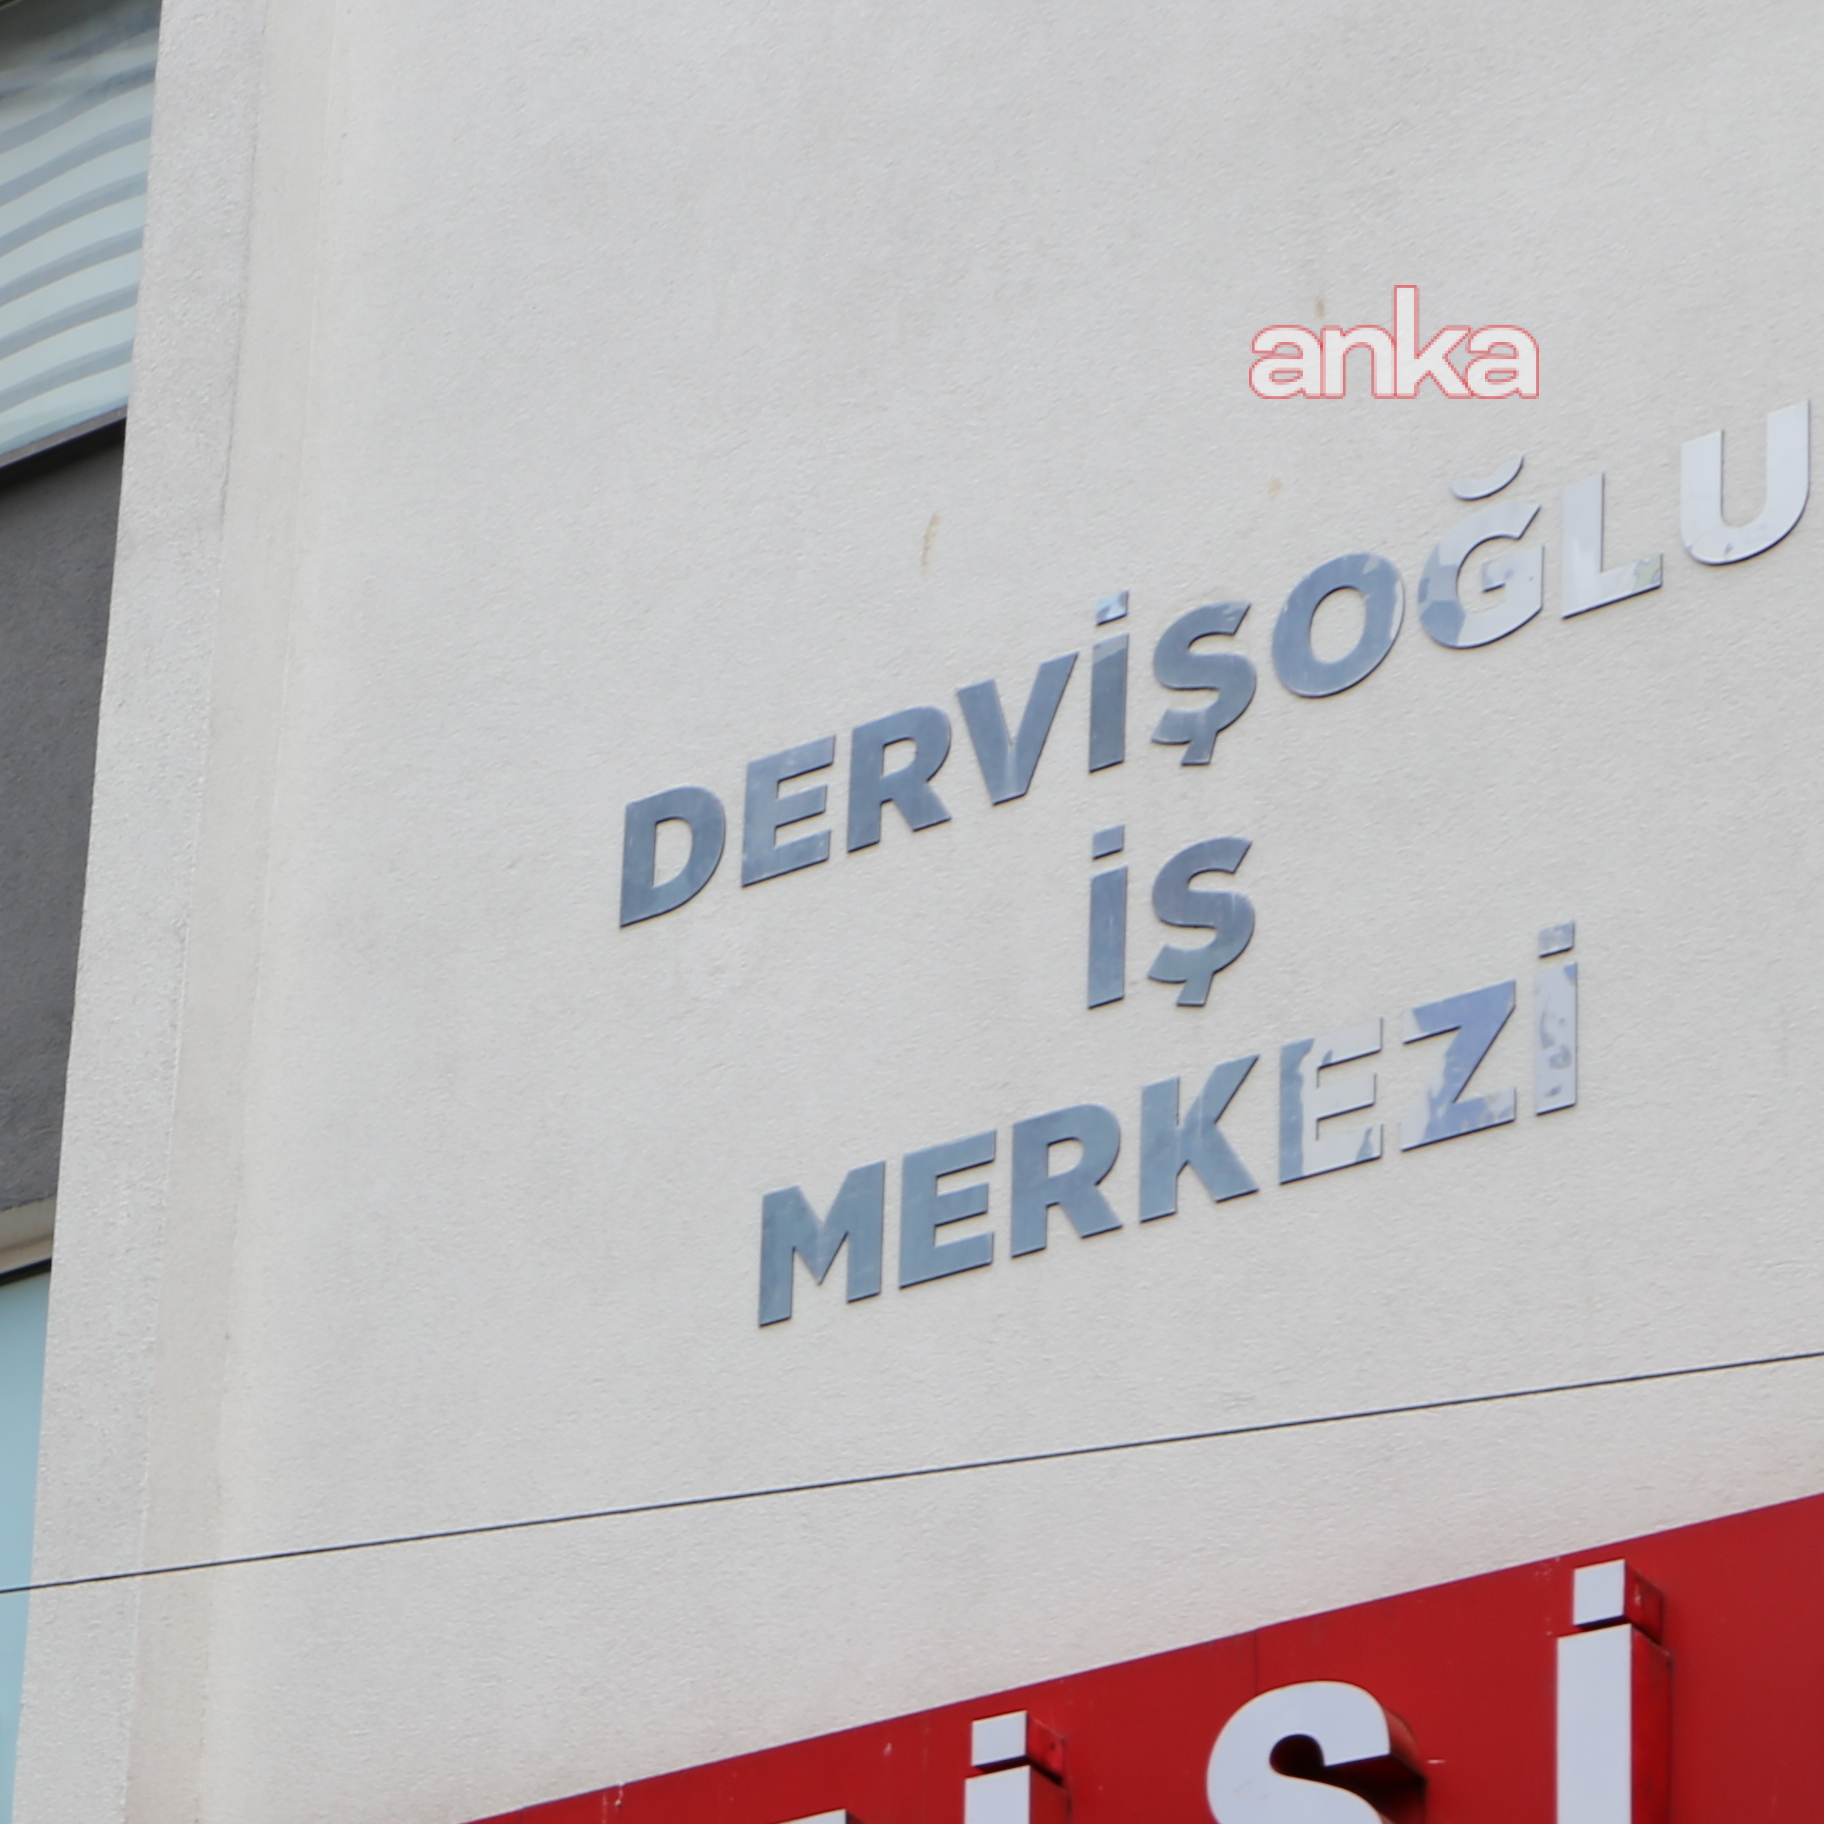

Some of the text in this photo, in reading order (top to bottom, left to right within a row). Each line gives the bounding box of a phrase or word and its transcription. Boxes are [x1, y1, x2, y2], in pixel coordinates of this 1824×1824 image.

[619, 400, 1811, 928] DERVİŞOĞLU
[1087, 825, 1257, 1009] İŞ
[758, 920, 1579, 1329] MERKEZİ
